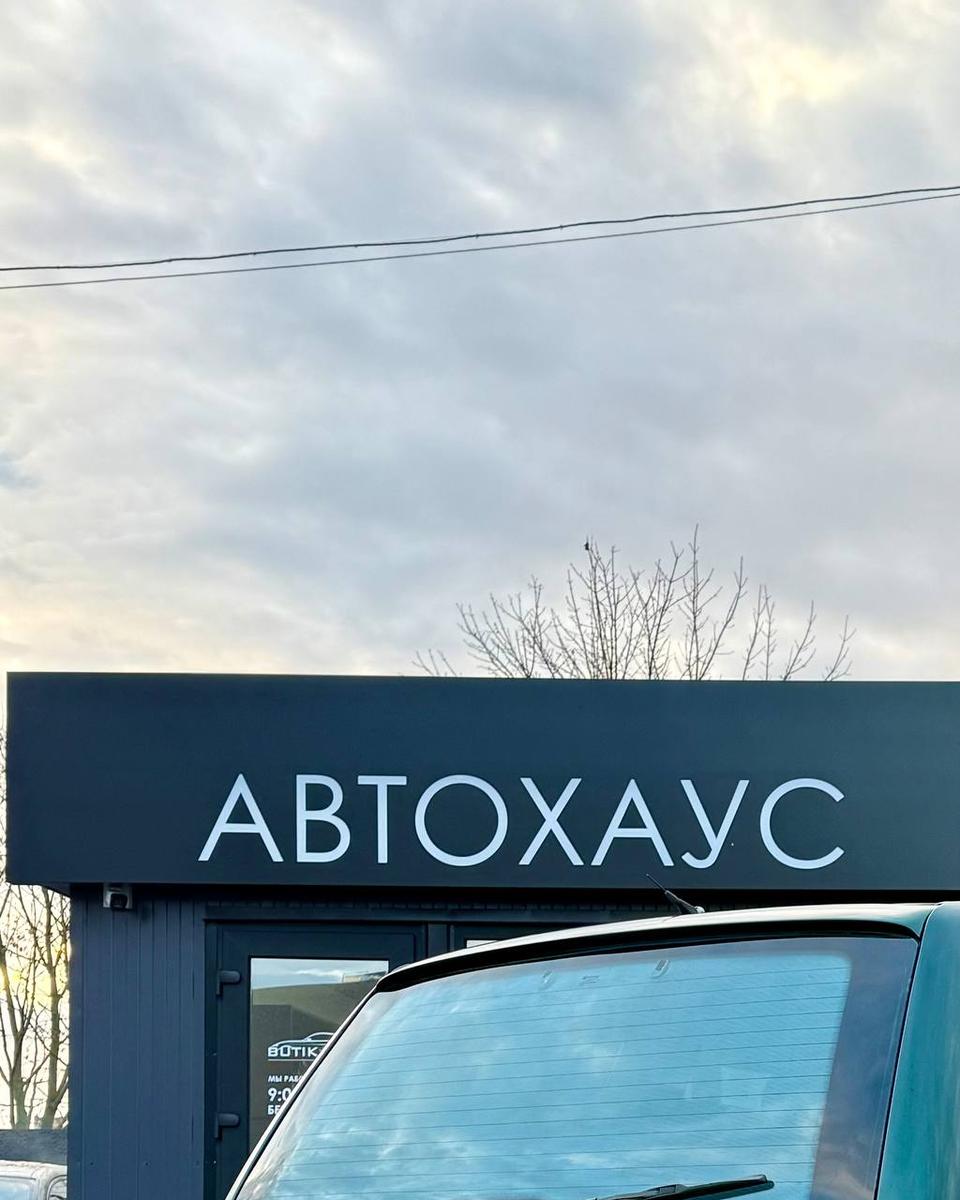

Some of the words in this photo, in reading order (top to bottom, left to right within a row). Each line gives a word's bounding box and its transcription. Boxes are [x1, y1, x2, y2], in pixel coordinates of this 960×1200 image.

[197, 773, 846, 870] АВТОХАУС
[268, 1046, 320, 1057] BUTIK
[284, 1075, 301, 1083] РАБ
